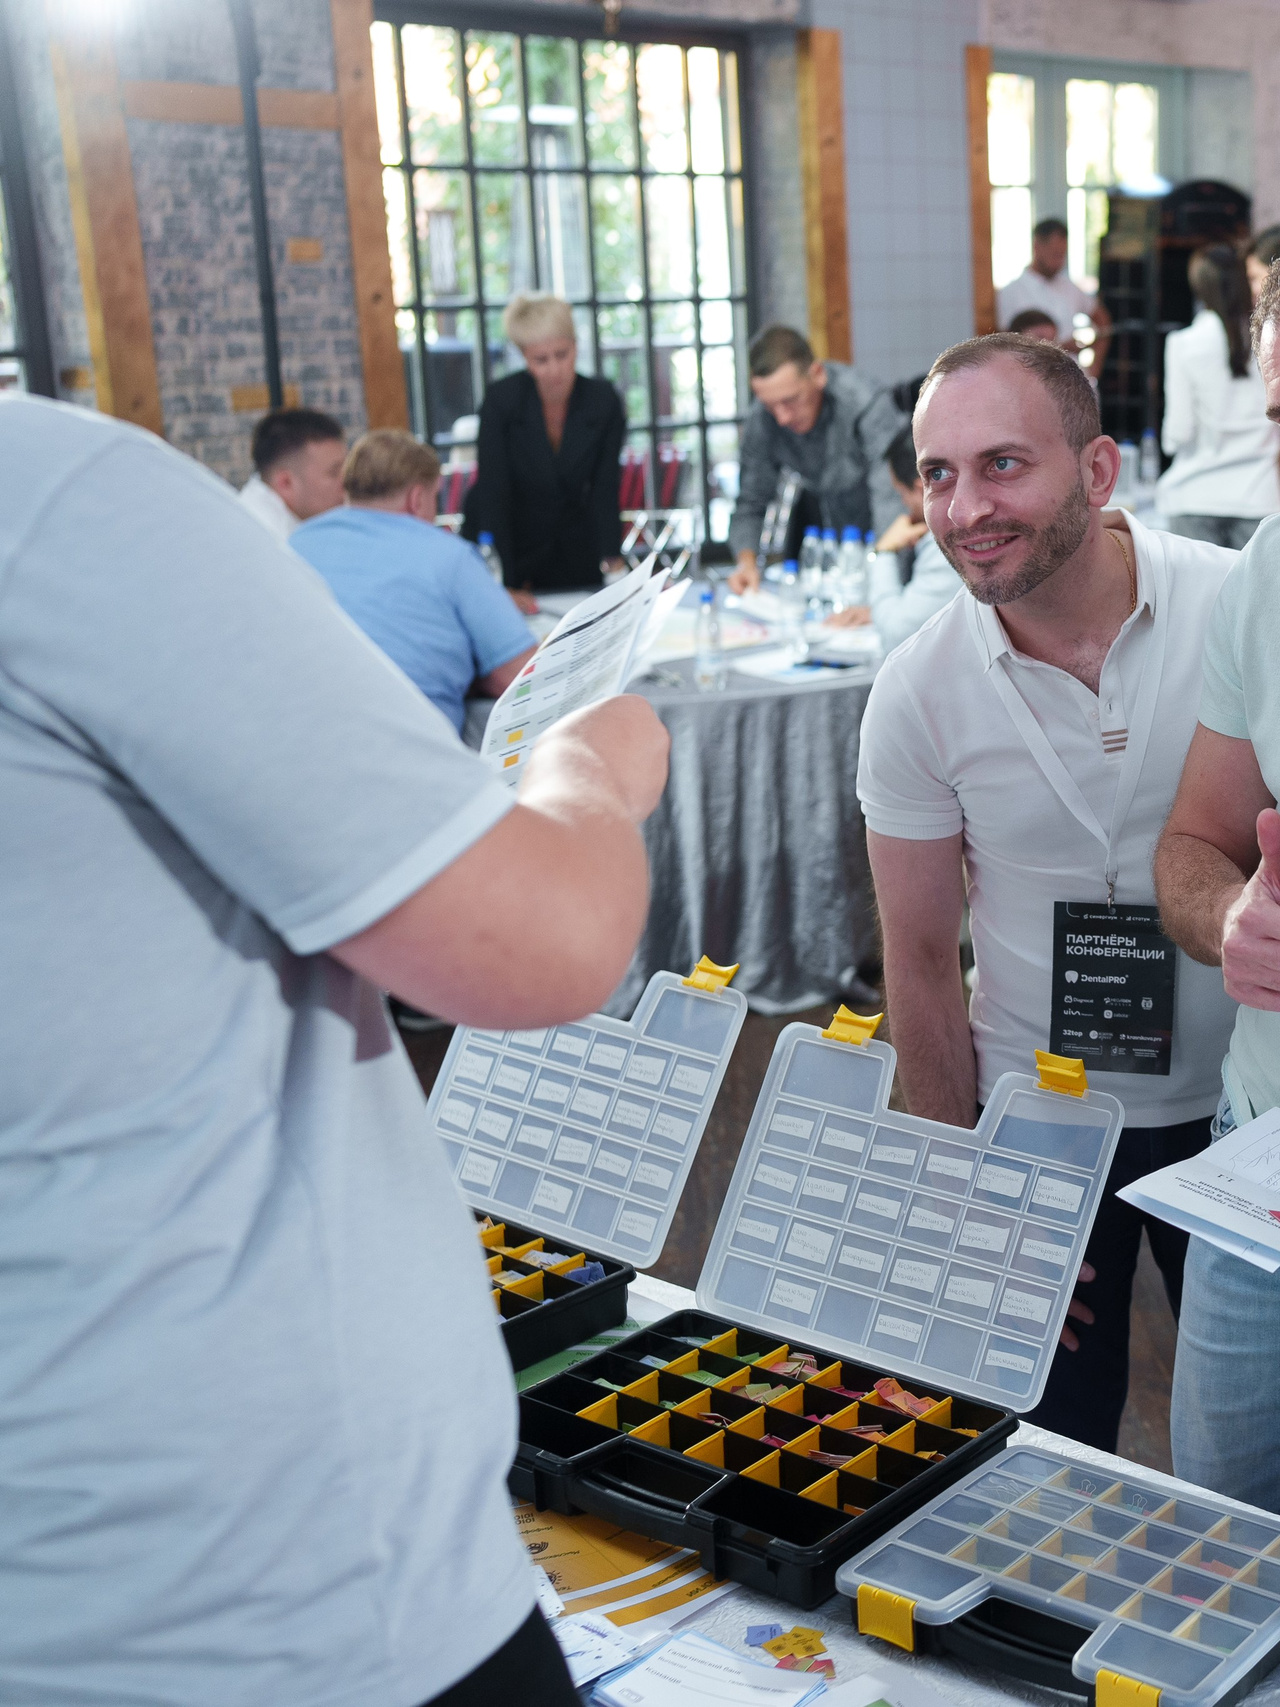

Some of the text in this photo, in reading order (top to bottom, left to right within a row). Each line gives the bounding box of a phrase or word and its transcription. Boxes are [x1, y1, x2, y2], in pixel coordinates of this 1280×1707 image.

[1066, 934, 1136, 947] ПАРТНЁРЫ
[1066, 945, 1165, 960] КОНФЕРЕНЦИИ
[1062, 1029, 1083, 1037] 32top
